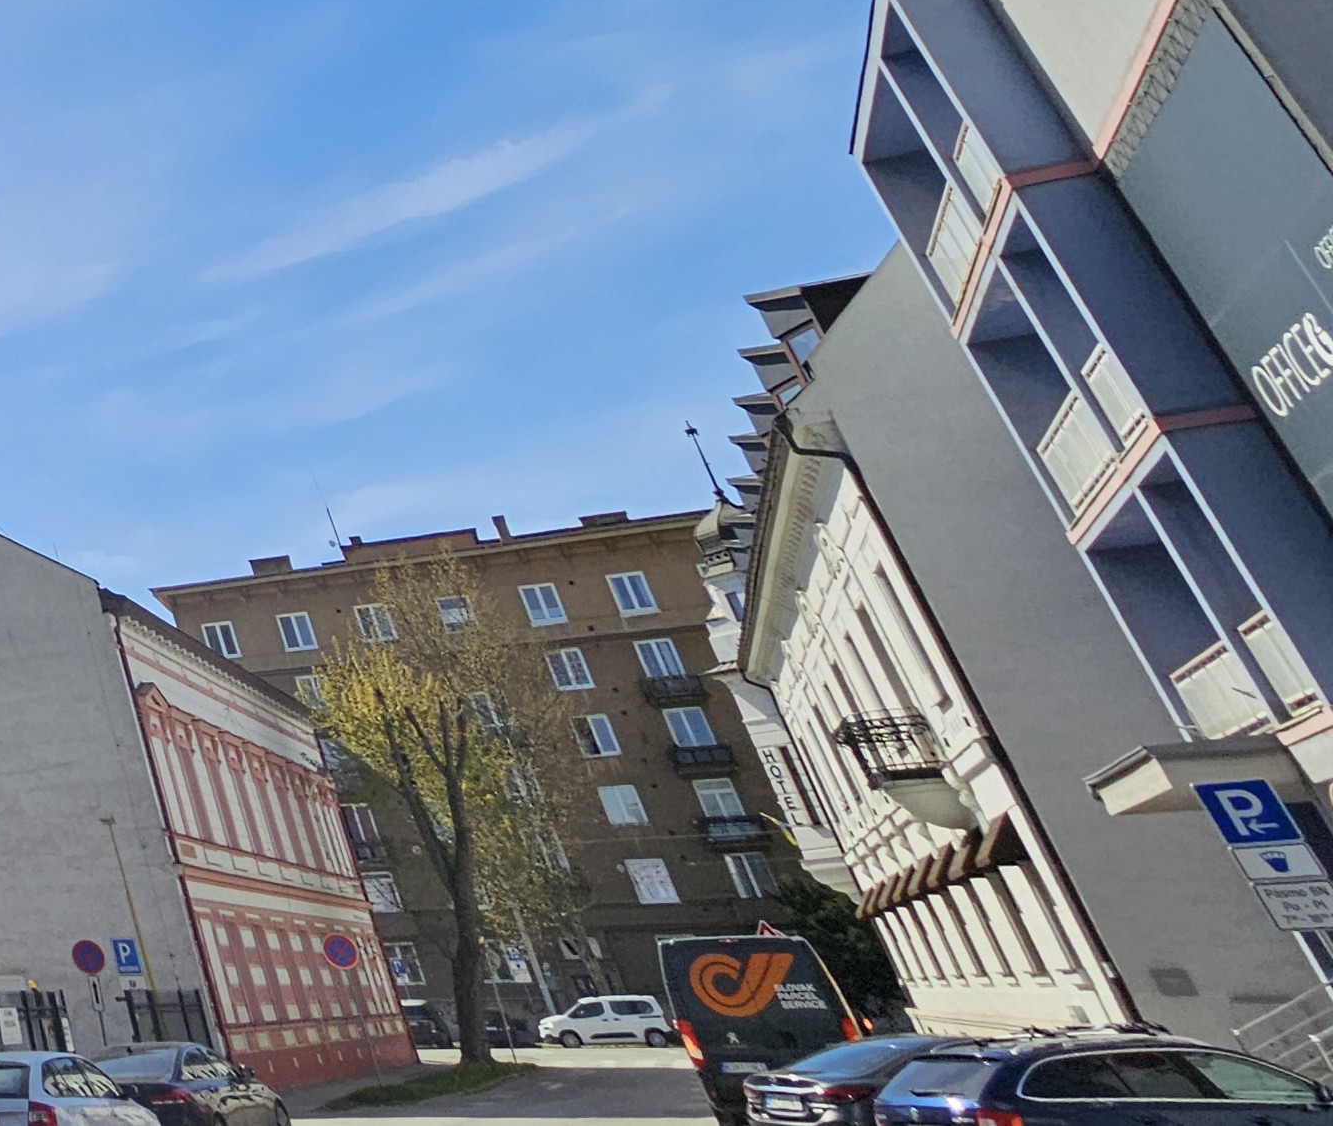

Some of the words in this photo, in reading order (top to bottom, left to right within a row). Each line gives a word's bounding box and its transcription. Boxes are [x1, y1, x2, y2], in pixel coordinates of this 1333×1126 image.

[762, 749, 804, 826] HOTEL
[1214, 789, 1263, 836] P
[118, 942, 131, 964] P
